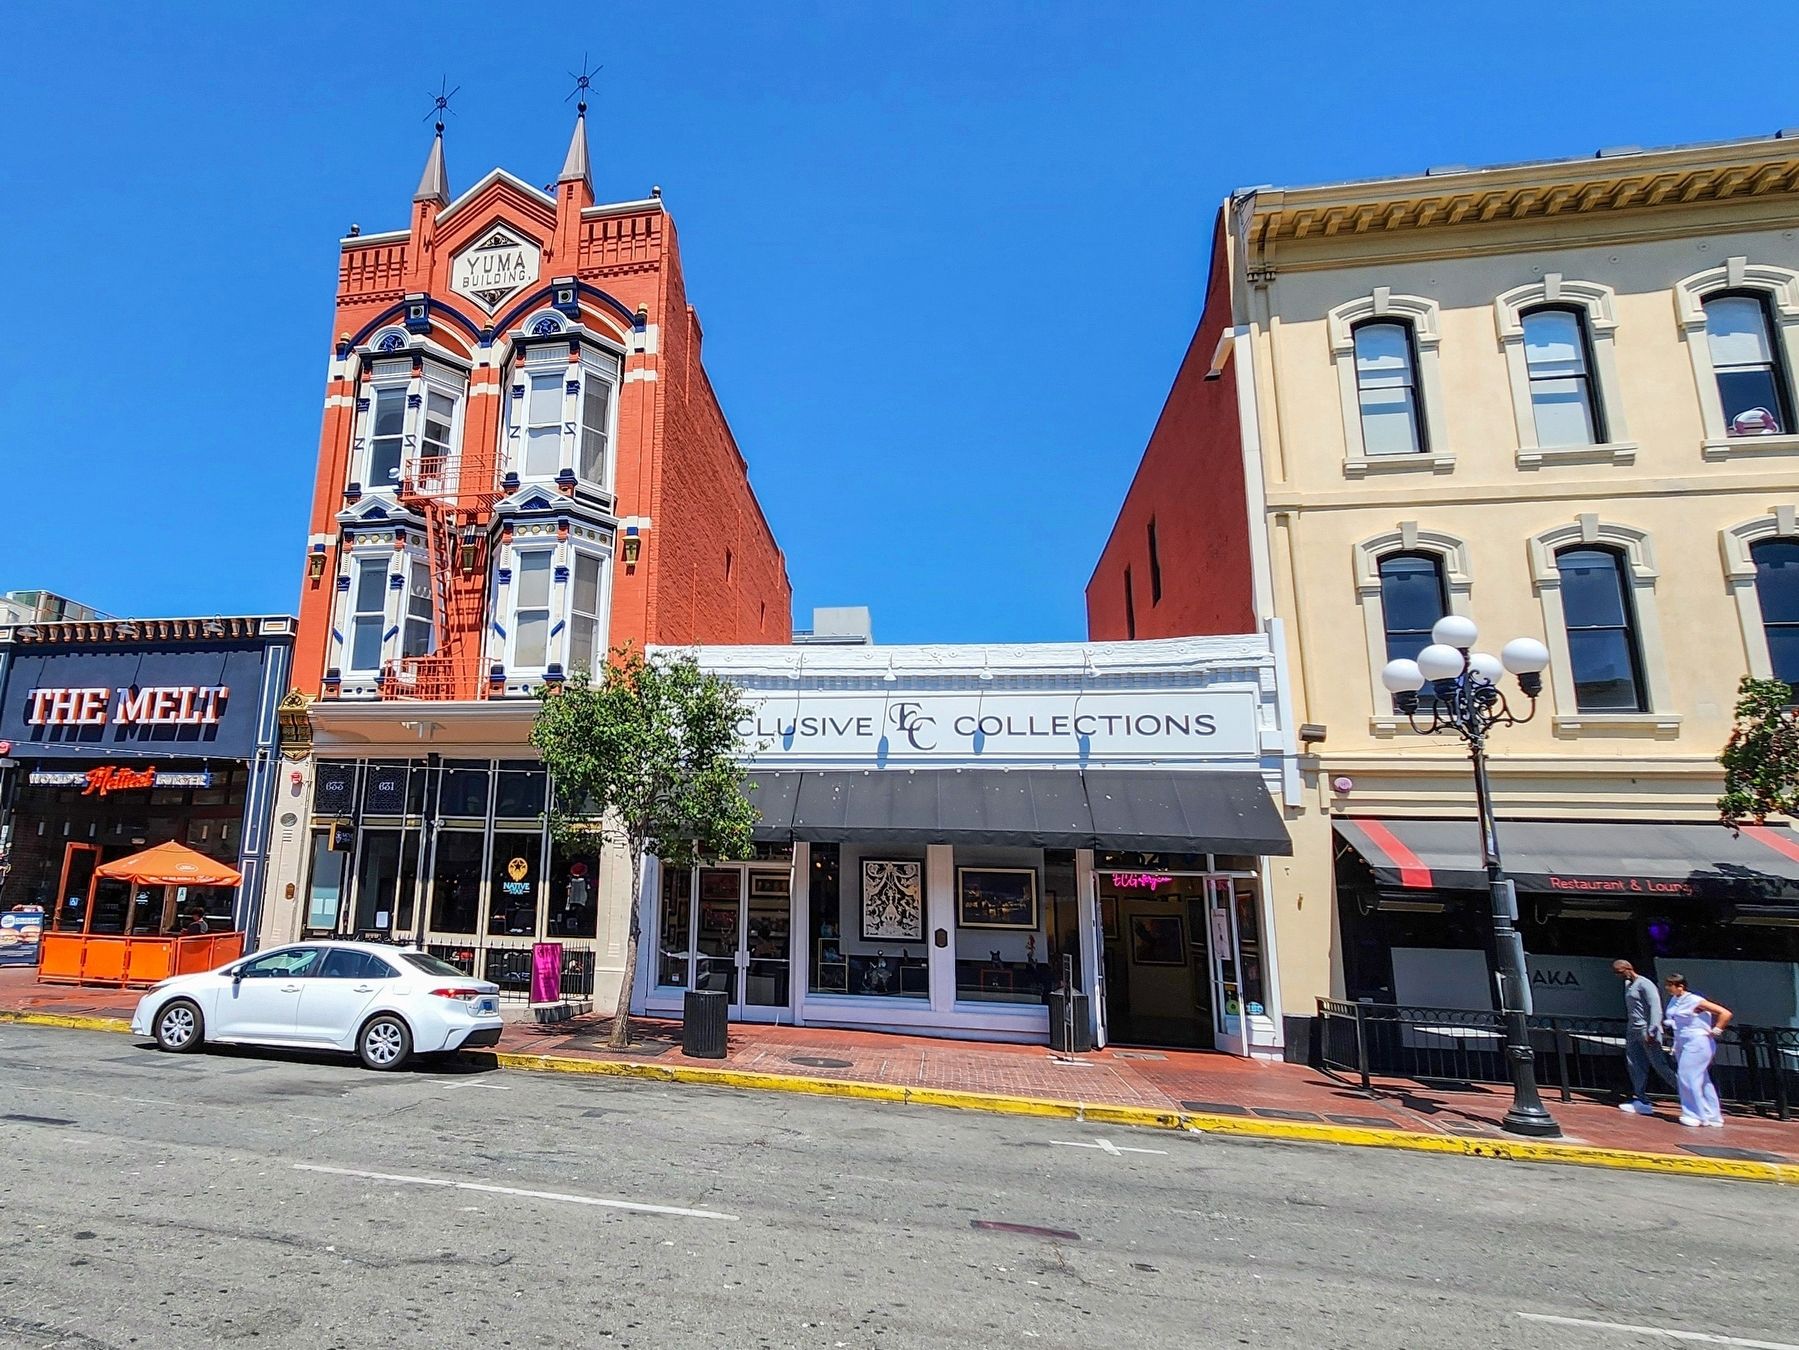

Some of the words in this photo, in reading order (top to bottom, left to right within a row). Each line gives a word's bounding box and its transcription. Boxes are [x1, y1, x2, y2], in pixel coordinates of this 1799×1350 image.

[467, 251, 526, 275] YUMA
[27, 687, 110, 724] THE
[112, 686, 228, 724] MELT
[732, 716, 873, 736] CLUSIVE
[954, 714, 1217, 737] COLLECTIONS
[379, 782, 394, 791] 631
[503, 882, 530, 890] NATIVE
[1550, 877, 1625, 890] Restaurant
[1630, 880, 1643, 892] &
[1647, 880, 1695, 895] Loung
